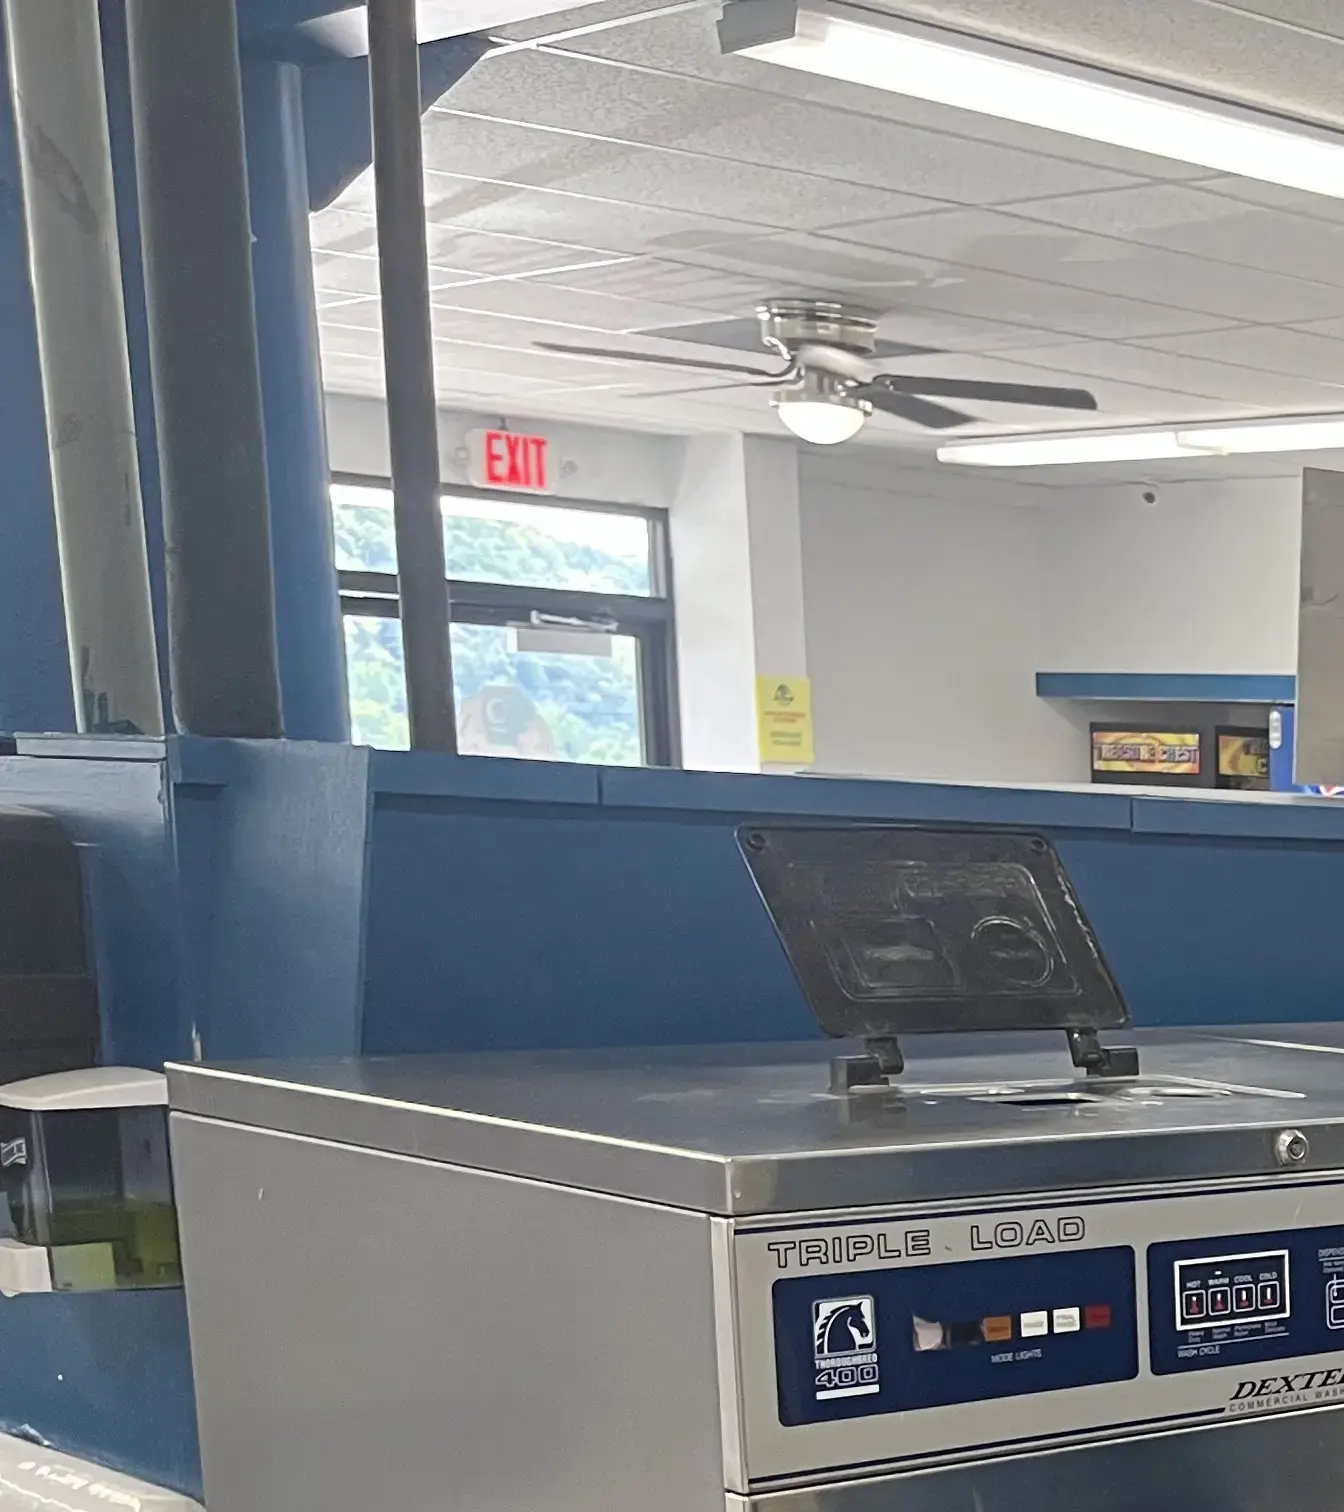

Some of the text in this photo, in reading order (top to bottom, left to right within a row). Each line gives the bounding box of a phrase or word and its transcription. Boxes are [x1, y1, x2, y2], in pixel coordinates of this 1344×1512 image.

[485, 431, 547, 489] EXIT
[767, 1216, 1086, 1269] TRIPLE LOAD
[1233, 1274, 1253, 1283] COOL
[1259, 1271, 1278, 1280] COLD
[990, 1348, 1042, 1364] MODE LIGHTS
[1199, 1345, 1221, 1356] CYCLE
[815, 1353, 878, 1370] THOROUGHBRED
[815, 1363, 879, 1388] 400
[1228, 1393, 1308, 1413] COMMERCIAL
